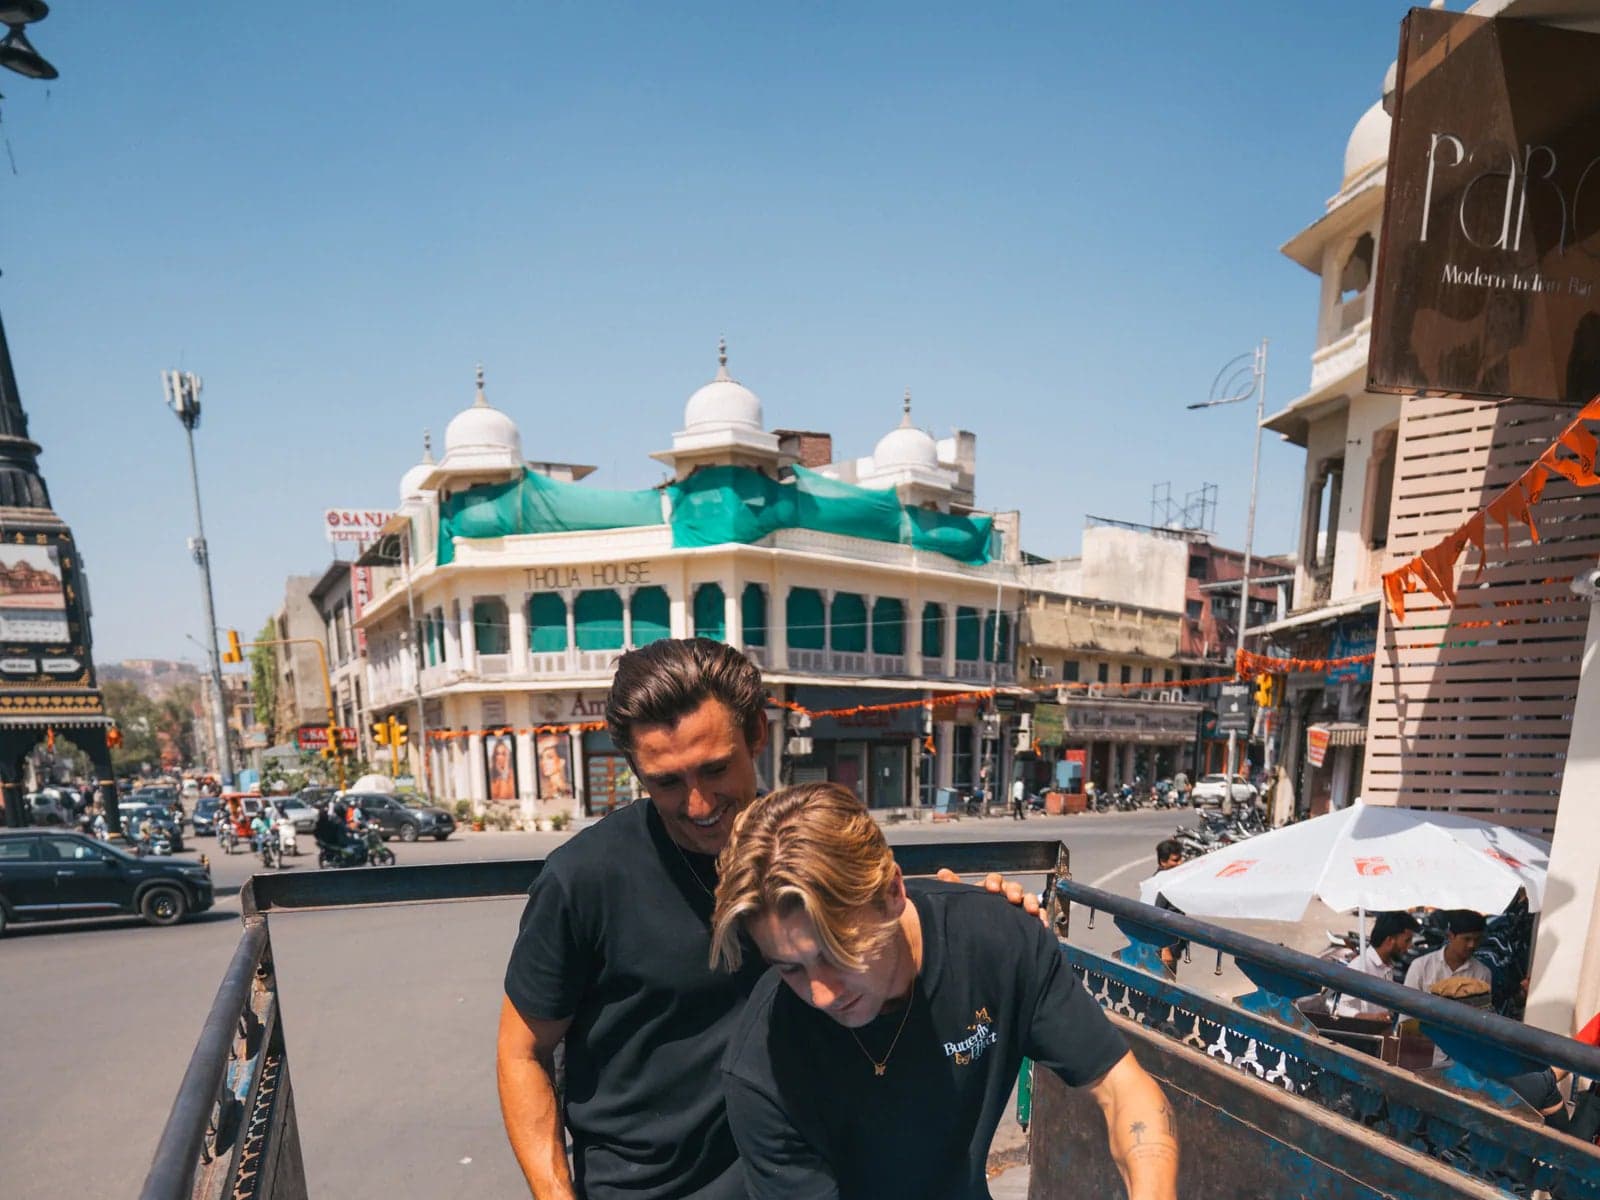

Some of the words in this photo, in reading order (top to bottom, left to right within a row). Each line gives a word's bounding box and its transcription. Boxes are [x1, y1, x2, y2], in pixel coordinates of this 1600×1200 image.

[1441, 264, 1507, 288] Modern
[523, 567, 581, 589] THOLIA
[591, 560, 650, 585] HOUSE
[944, 1023, 989, 1056] Butterfly
